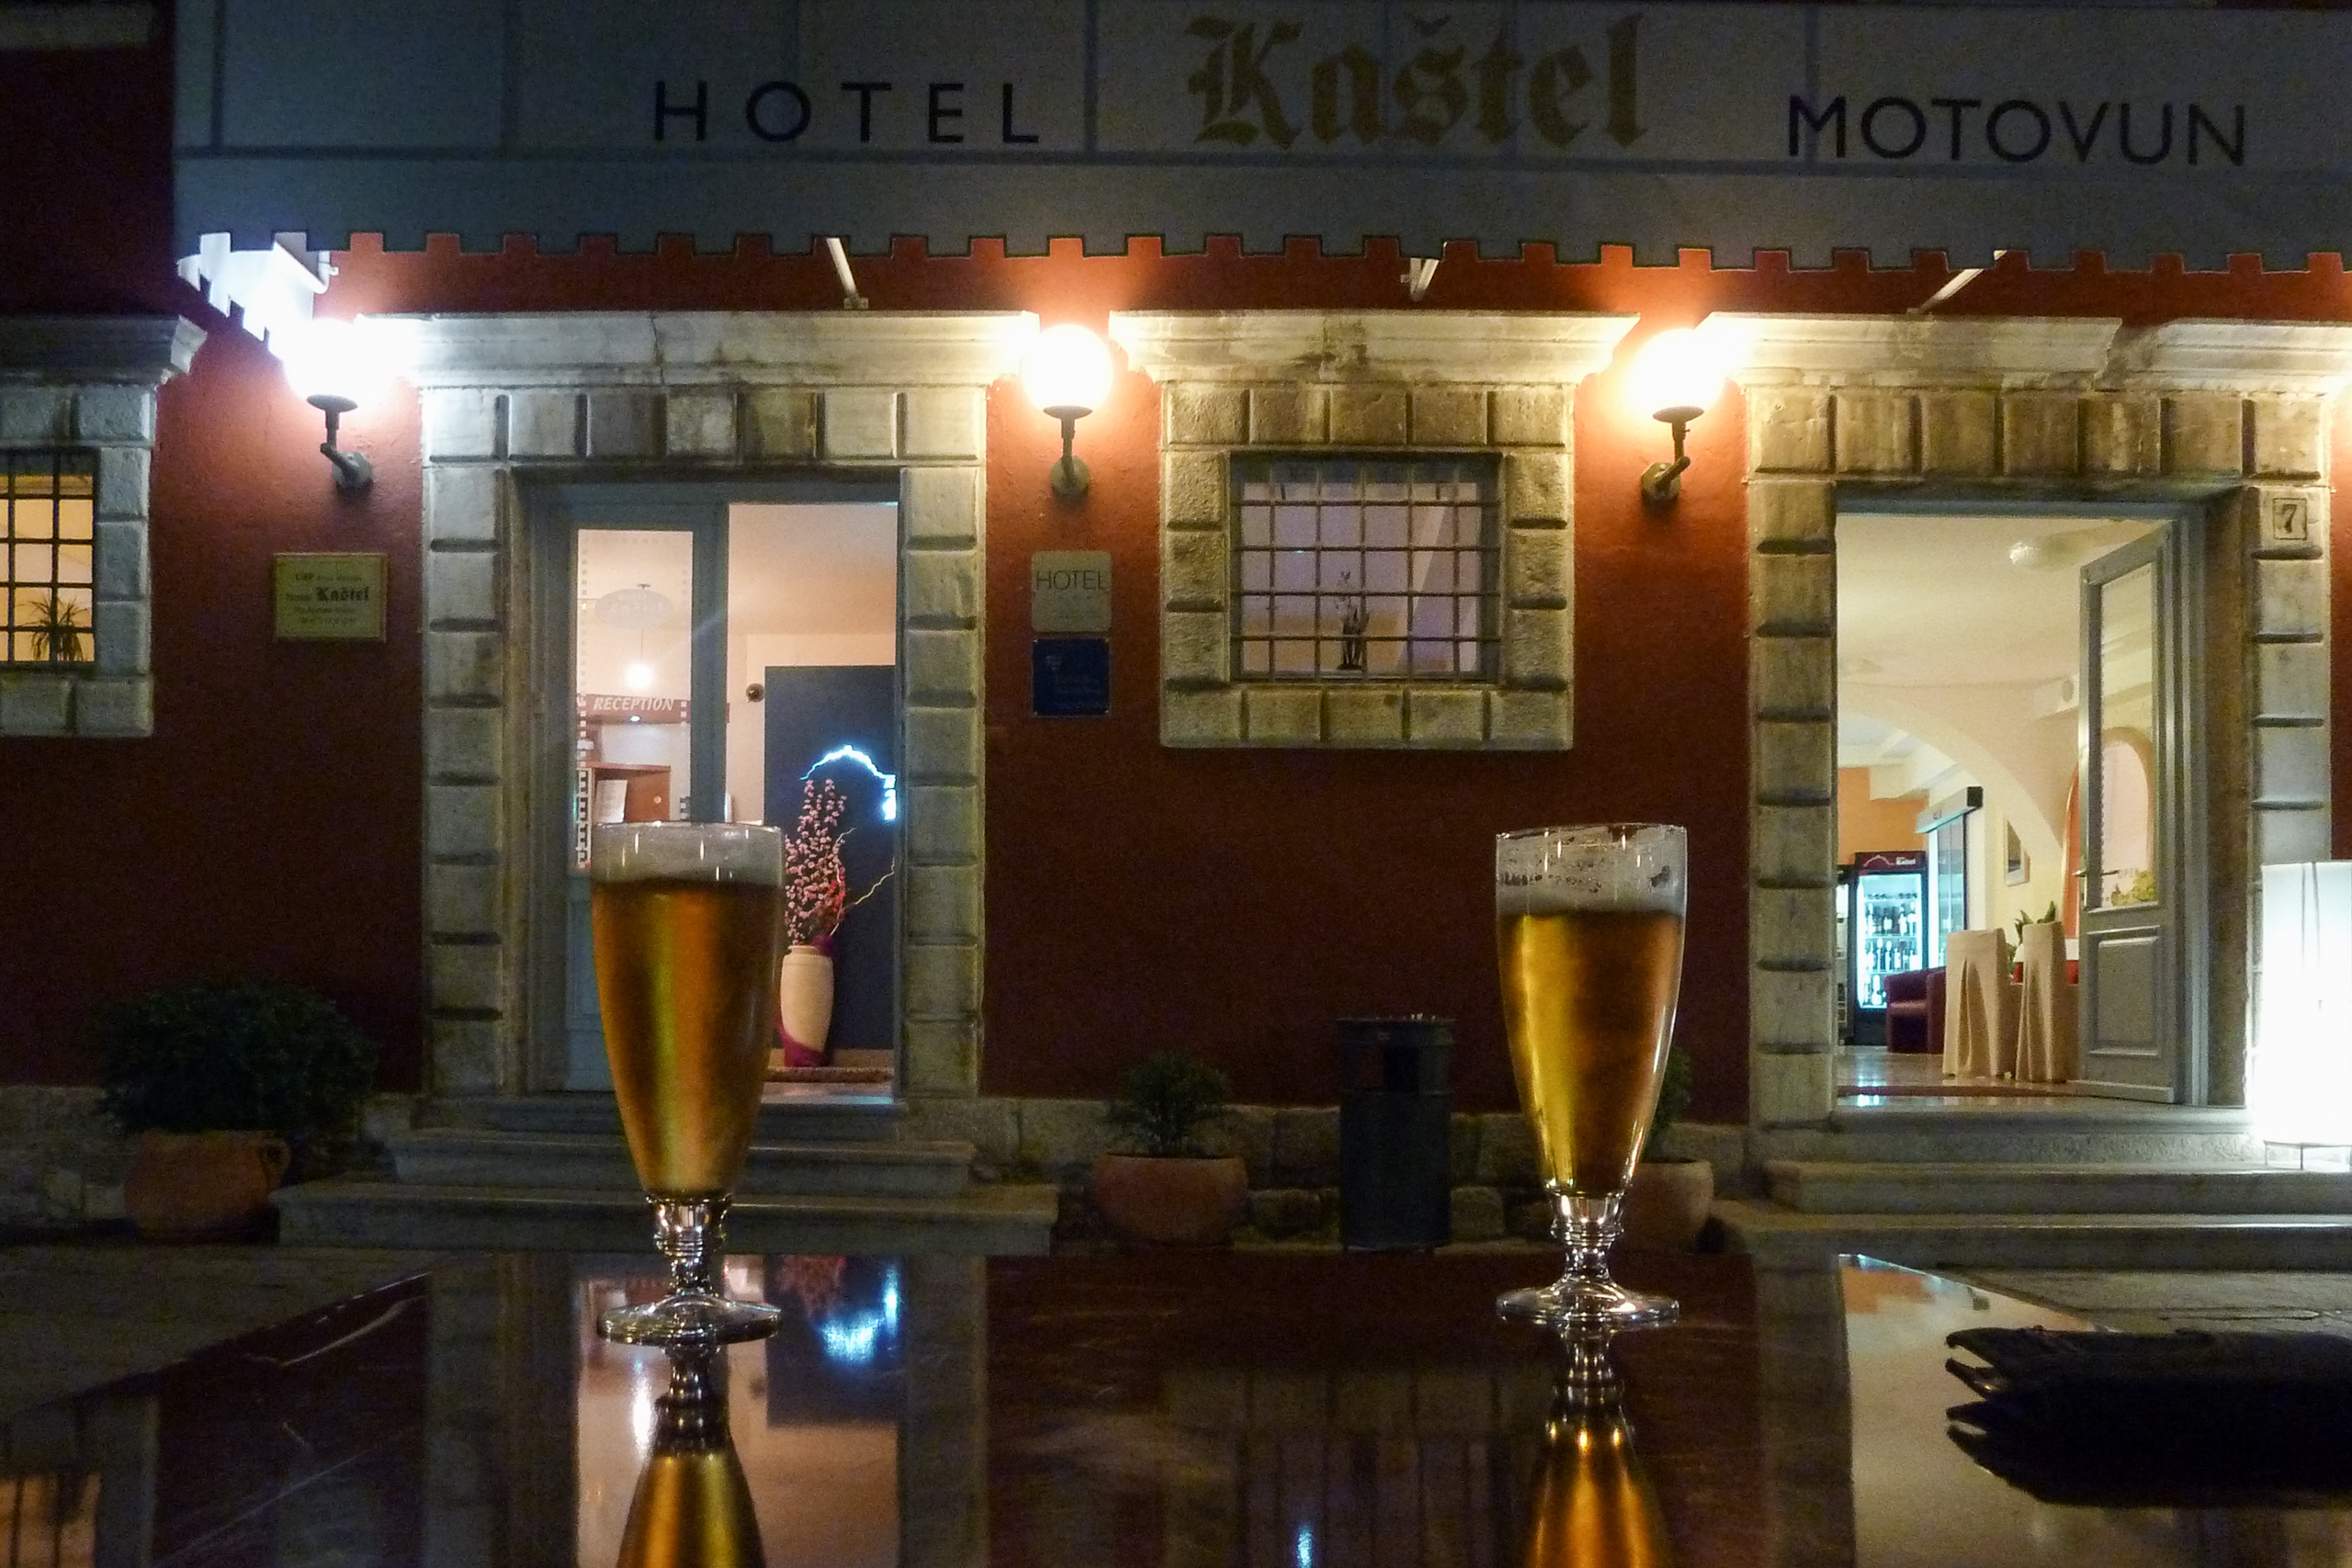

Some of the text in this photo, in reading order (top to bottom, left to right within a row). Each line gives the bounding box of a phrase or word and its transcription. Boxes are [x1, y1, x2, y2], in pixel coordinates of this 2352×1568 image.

[652, 12, 2245, 166] HOTEL Kaštel MOTOVUN
[2282, 503, 2297, 534] 7
[1036, 570, 1107, 590] HOTEL
[593, 696, 675, 711] RECEPTION
